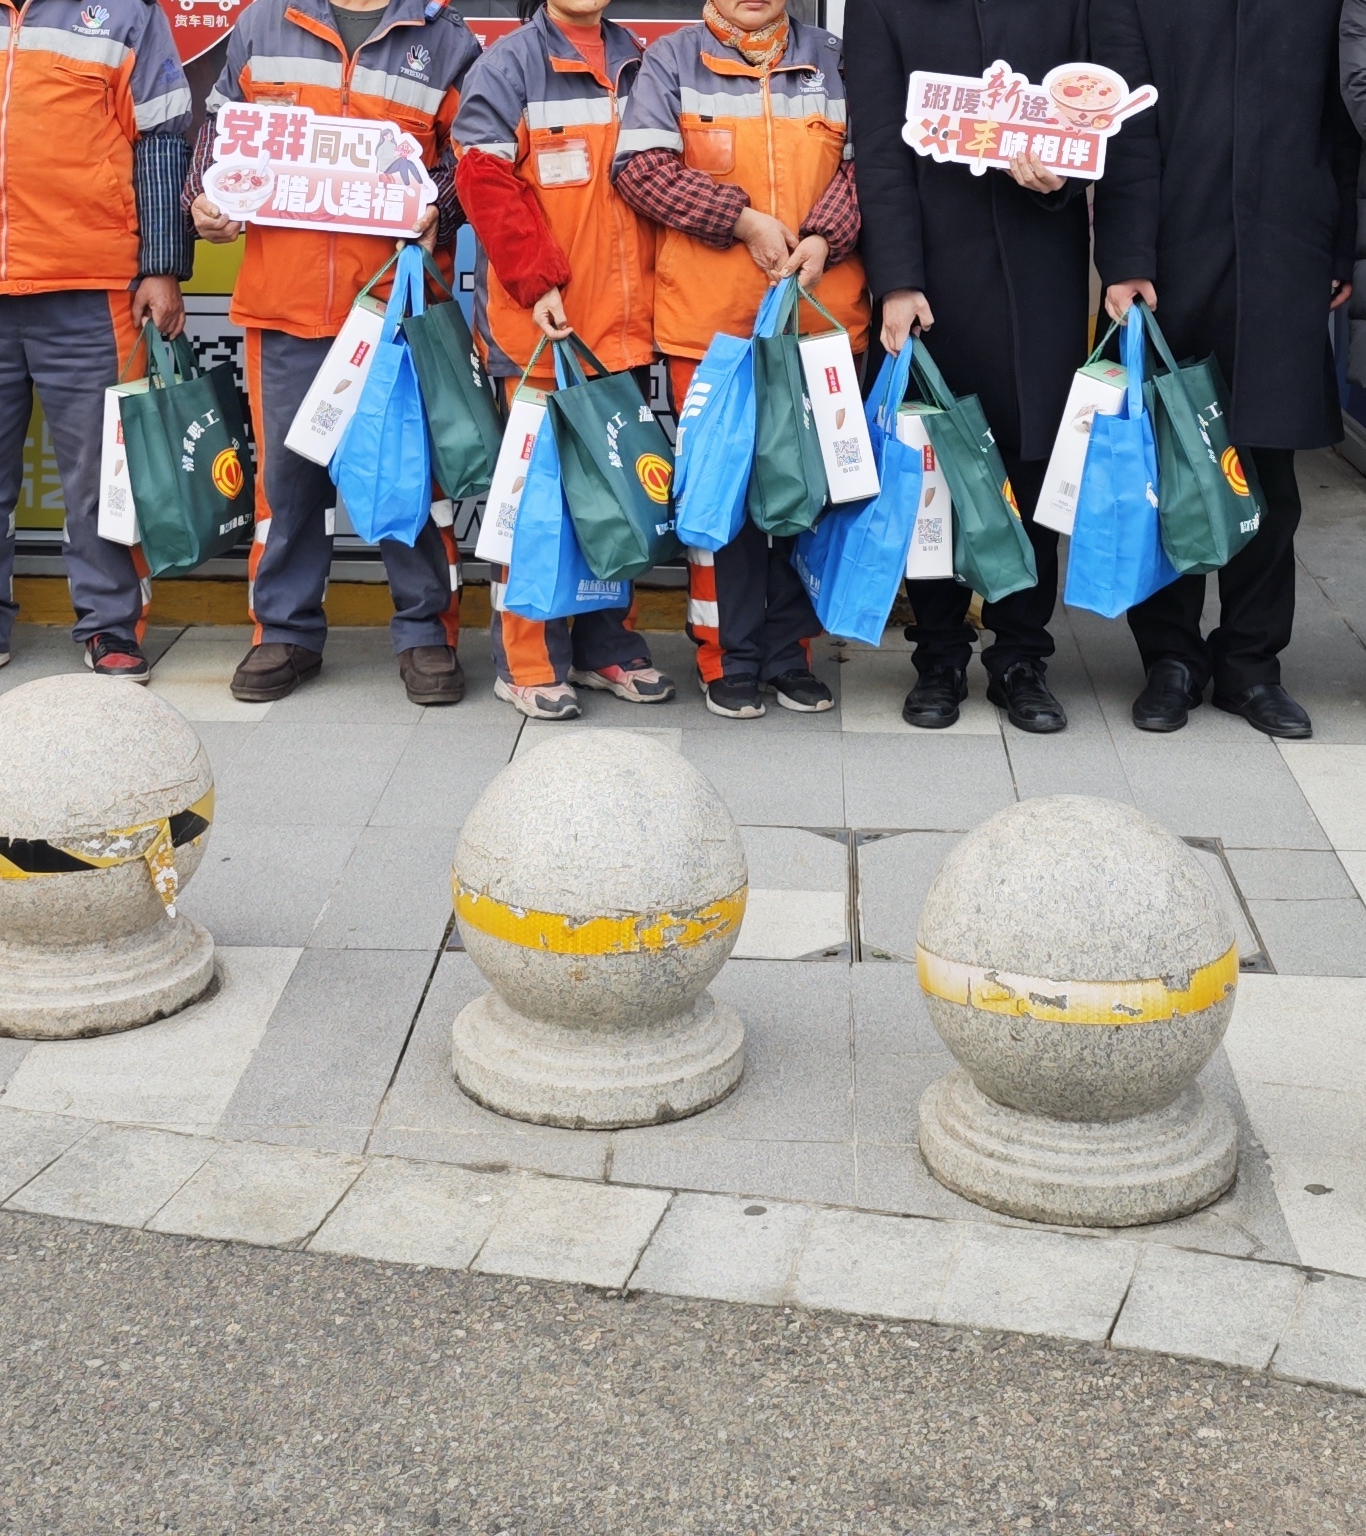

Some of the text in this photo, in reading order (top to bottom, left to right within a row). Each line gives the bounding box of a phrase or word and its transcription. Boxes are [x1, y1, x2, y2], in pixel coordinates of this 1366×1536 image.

[173, 14, 230, 29] 货车司机
[921, 66, 1050, 122] 粥暖新途
[219, 108, 373, 169] 党群同心
[964, 116, 1092, 168] 丰味相伴
[271, 173, 408, 222] 腊八送福
